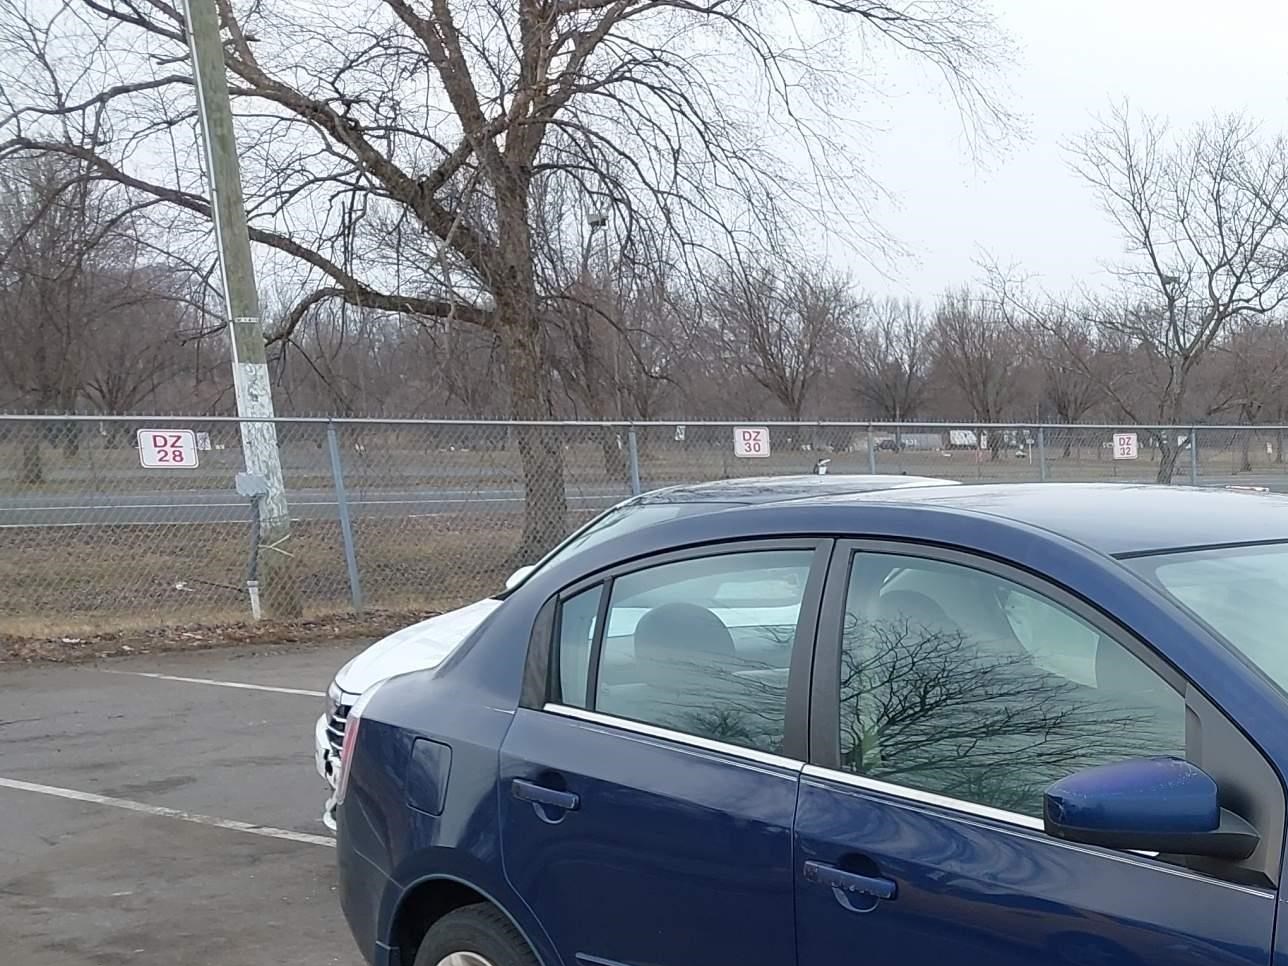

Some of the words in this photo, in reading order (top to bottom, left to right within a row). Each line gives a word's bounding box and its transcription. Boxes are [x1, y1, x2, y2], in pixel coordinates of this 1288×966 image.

[152, 434, 184, 449] DZ
[742, 430, 761, 442] DZ
[1118, 436, 1132, 446] DZ
[744, 442, 761, 453] 30
[1119, 446, 1132, 456] 32
[156, 449, 185, 463] 28
